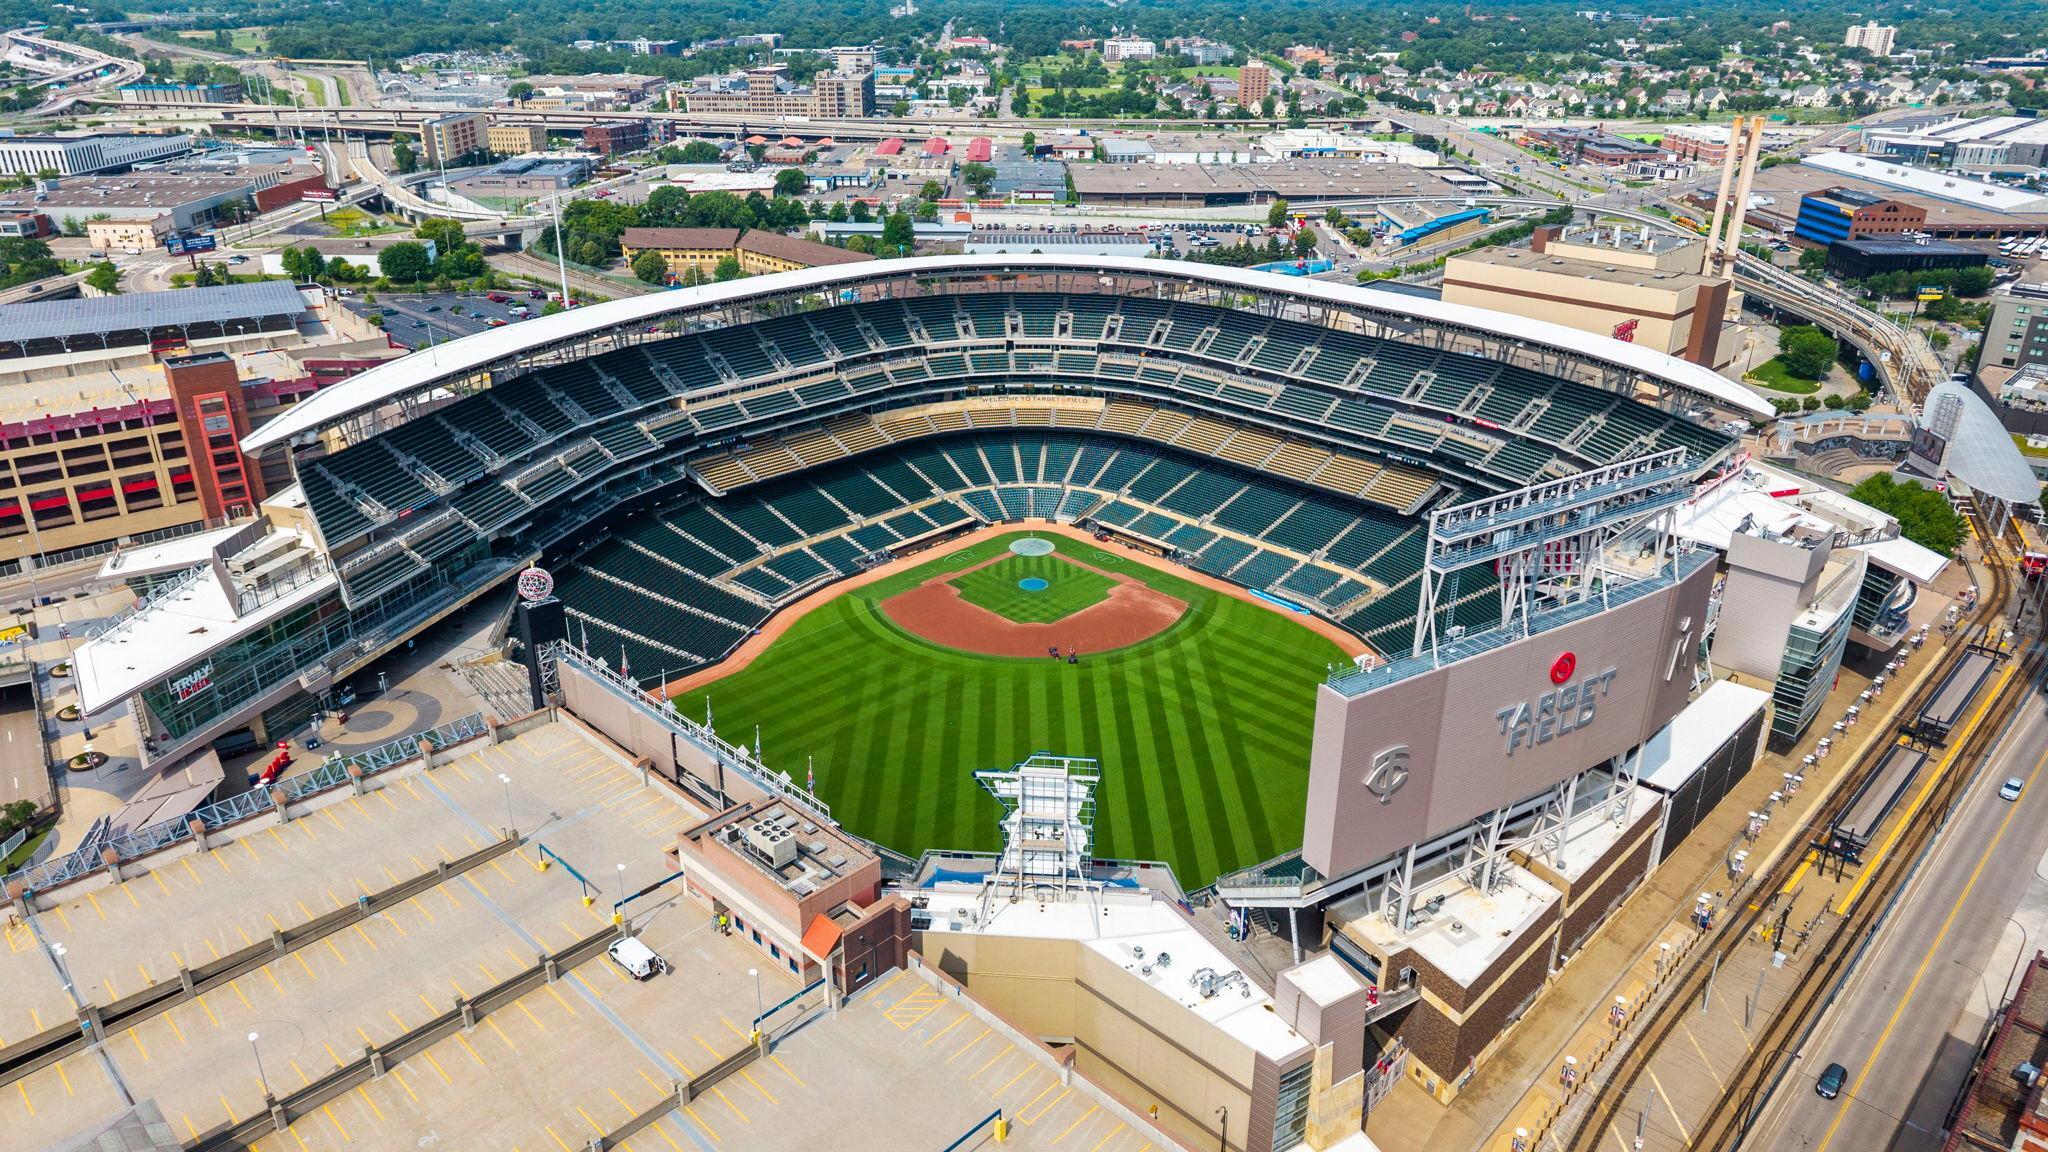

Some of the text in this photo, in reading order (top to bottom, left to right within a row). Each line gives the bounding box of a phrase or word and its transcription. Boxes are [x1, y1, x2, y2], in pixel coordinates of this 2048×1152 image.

[172, 665, 210, 691] TRULY
[1496, 665, 1618, 735] TARGET
[1506, 701, 1597, 757] FIELD
